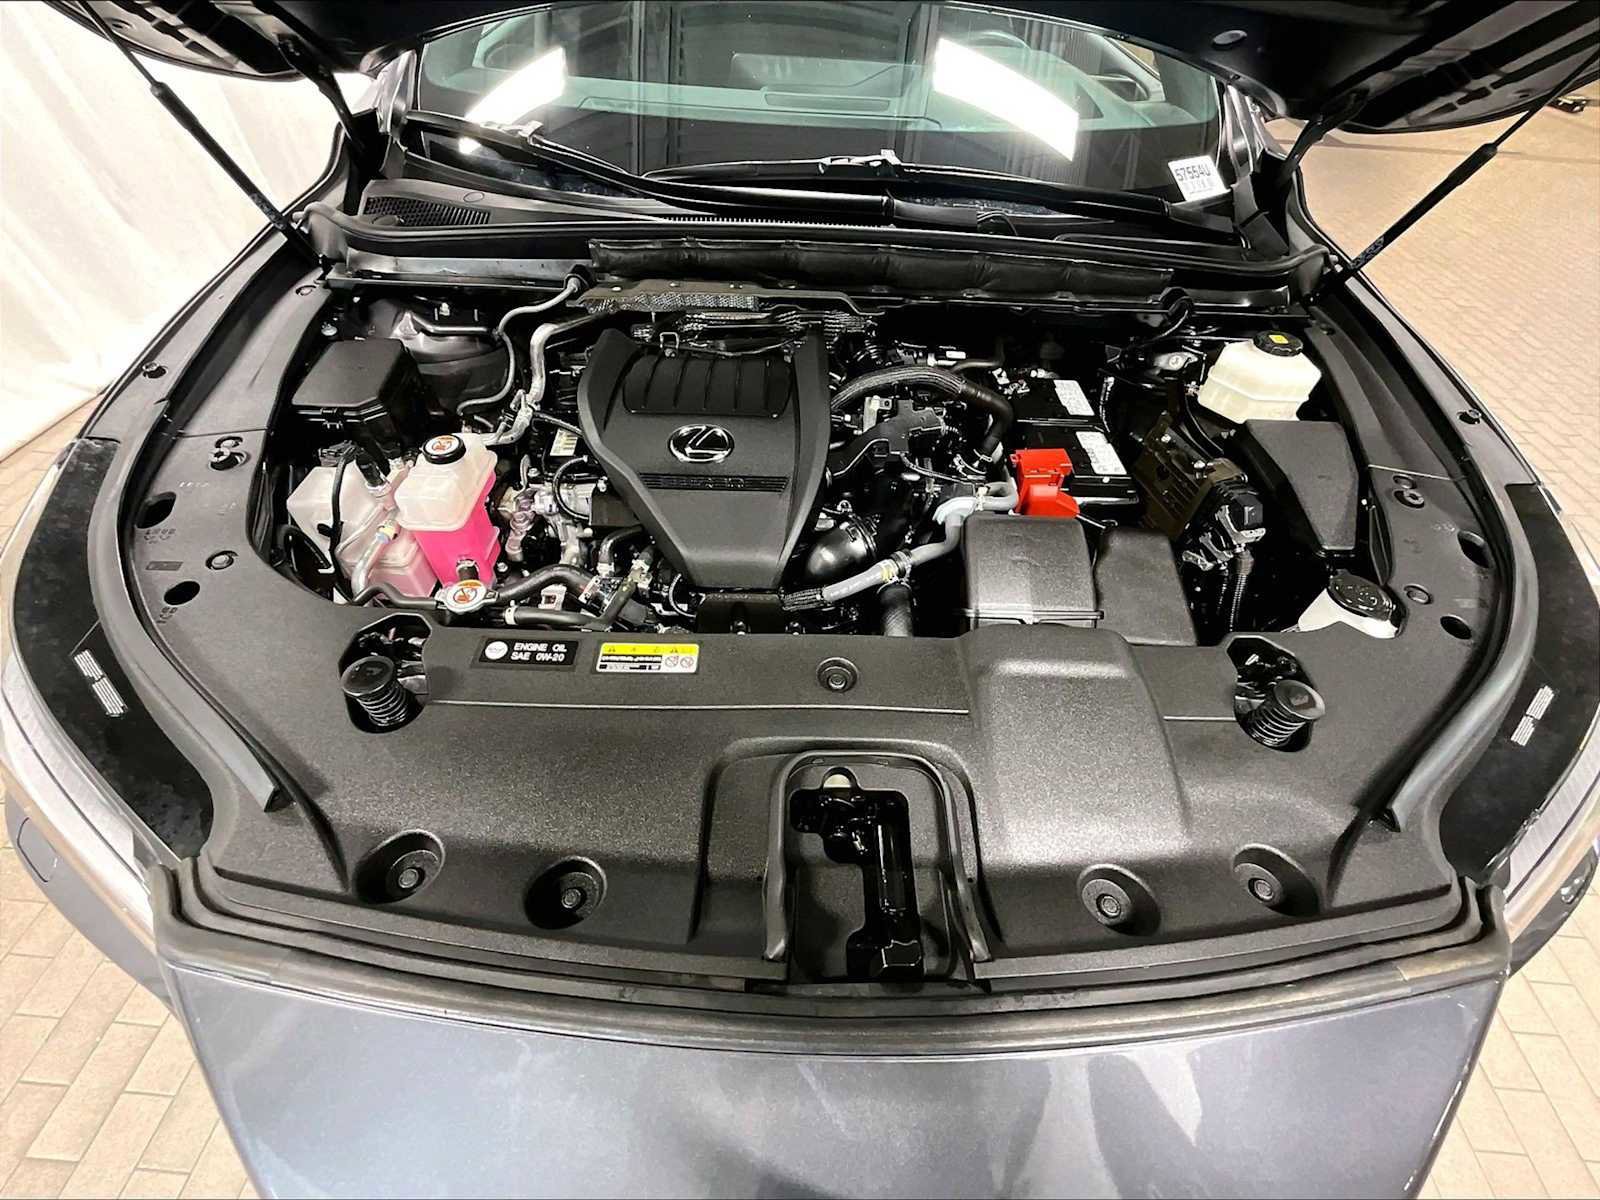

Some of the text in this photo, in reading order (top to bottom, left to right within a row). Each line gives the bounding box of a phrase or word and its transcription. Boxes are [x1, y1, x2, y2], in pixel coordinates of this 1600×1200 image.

[513, 642, 549, 652] ENGINE
[552, 643, 568, 653] OIL
[510, 651, 566, 662] SAE 0W-20
